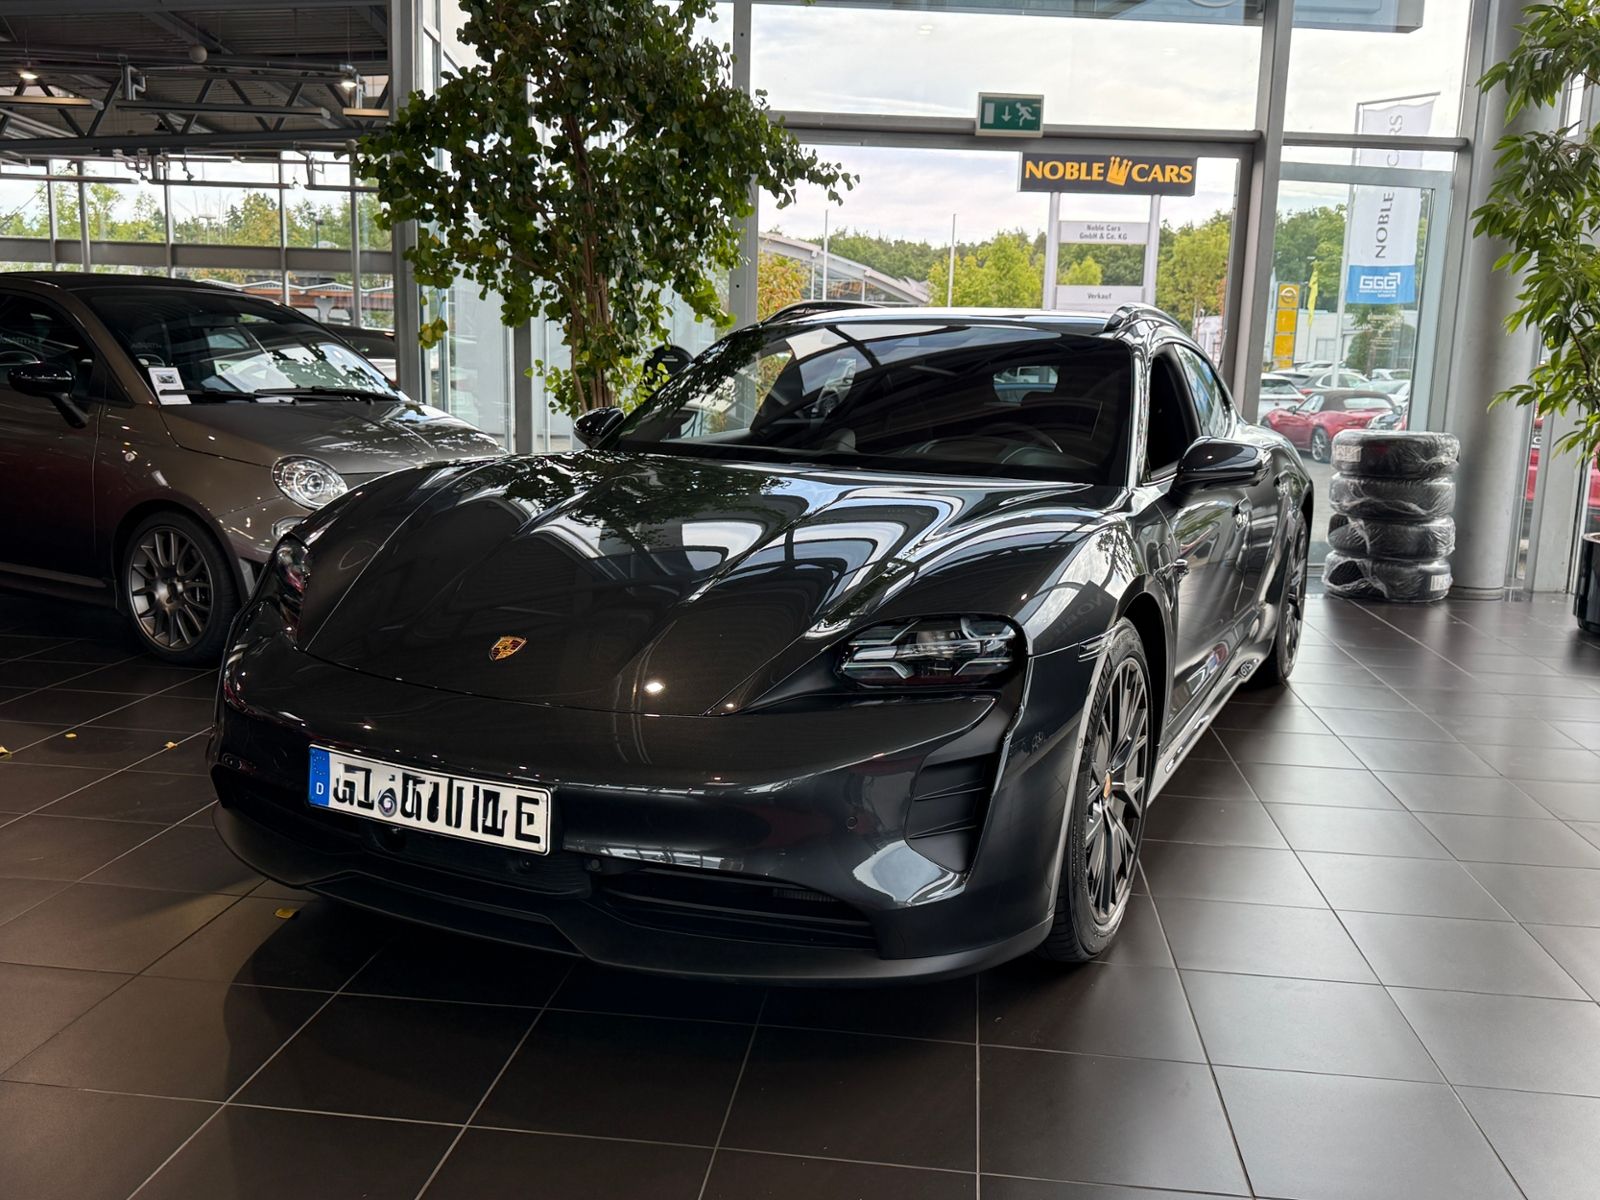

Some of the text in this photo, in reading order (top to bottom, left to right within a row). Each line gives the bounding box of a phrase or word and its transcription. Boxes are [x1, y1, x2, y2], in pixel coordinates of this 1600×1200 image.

[1025, 160, 1193, 184] NOBLE CARS
[1375, 113, 1405, 259] NOBLE CRS
[1086, 224, 1121, 232] Noble Cars
[1079, 232, 1098, 240] GmbH
[1098, 232, 1104, 240] &
[1087, 292, 1112, 300] Verkauf
[316, 782, 324, 795] D
